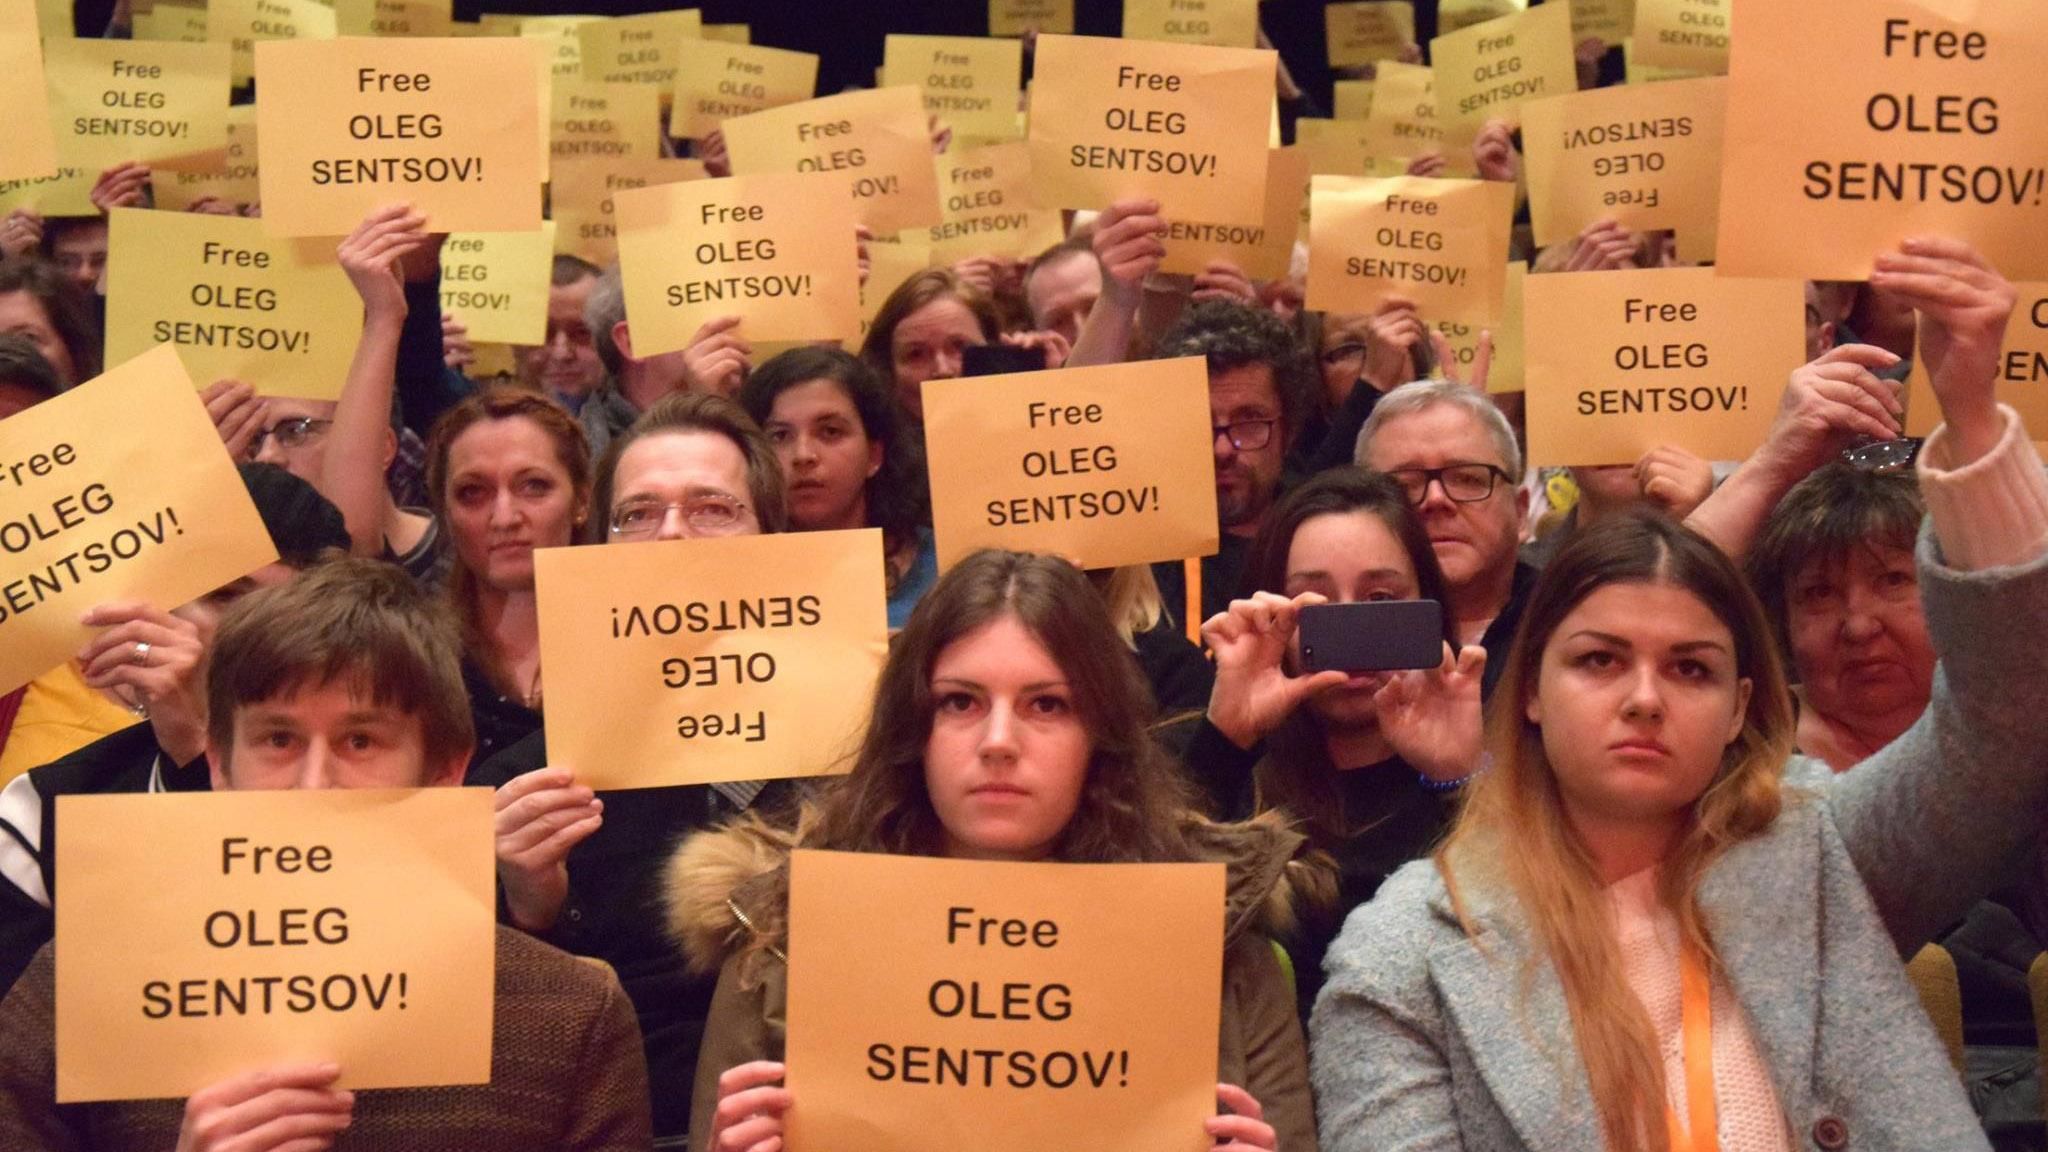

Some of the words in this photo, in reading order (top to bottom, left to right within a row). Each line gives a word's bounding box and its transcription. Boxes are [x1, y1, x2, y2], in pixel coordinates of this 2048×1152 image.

[251, 20, 297, 37] OLEG
[1164, 20, 1210, 35] OLEG
[1679, 11, 1725, 28] OLEG
[1478, 34, 1515, 55] Free
[1658, 29, 1728, 48] SENTSO
[1884, 19, 1987, 60] Free
[113, 60, 162, 79] Free
[617, 48, 661, 65] OLEG
[727, 57, 764, 75] Free
[933, 50, 970, 66] Free
[358, 68, 431, 93] Free
[927, 74, 974, 90] OLEG
[1117, 66, 1181, 92] Free
[1474, 57, 1522, 83] OLEG
[102, 90, 166, 110] OLEG
[719, 79, 766, 99] OLEG
[1459, 76, 1546, 115] SENTSOV!
[922, 95, 992, 112] NTSOV!
[1866, 93, 1998, 135] OLEG
[73, 118, 188, 138] SENTSOV!
[349, 114, 443, 140] OLEG
[564, 119, 612, 133] OLEG
[797, 120, 852, 142] Free
[1105, 108, 1187, 135] OLEG
[1393, 123, 1444, 139] SENT
[1564, 117, 1693, 150] SENTSOV!
[312, 158, 482, 185] SENTSOV!
[797, 148, 867, 173] OLEG
[1070, 145, 1217, 178] SENTSOV!
[1593, 152, 1665, 177] OLEG
[605, 173, 647, 190] Free
[951, 165, 994, 183] Free
[1803, 161, 2044, 206] SENTSOV!
[948, 189, 1003, 212] OLEG
[1385, 194, 1438, 216] Free
[1603, 188, 1658, 208] Free
[702, 204, 764, 225] Free
[929, 213, 1029, 242] SENTSOV!
[450, 239, 485, 253] ree
[696, 239, 776, 265] OLEG
[1376, 227, 1443, 252] OLEG
[203, 242, 270, 269] Free
[444, 265, 488, 282] LEG
[1345, 256, 1467, 287] SENTSOV!
[191, 284, 277, 312] OLEG
[443, 291, 510, 311] TSOV!
[667, 274, 812, 307] SENTSOV!
[1625, 299, 1697, 323] Free
[153, 320, 310, 354] SENTSOV!
[1615, 343, 1709, 371] OLEG
[1577, 385, 1748, 416] SENTSOV!
[1028, 402, 1103, 429] Free
[1022, 446, 1117, 478] OLEG
[0, 483, 114, 554] OLEG
[987, 486, 1159, 527] SENTSOV!
[611, 595, 821, 639] SENTSOV!
[662, 652, 776, 690] OLEG
[677, 711, 766, 743] Free
[222, 837, 334, 875] Free
[204, 907, 350, 949] OLEG
[946, 906, 1060, 949] Free
[142, 972, 408, 1019] SENTSOV!
[928, 979, 1073, 1022] OLEG
[866, 1043, 1130, 1090] SENTSOV!
